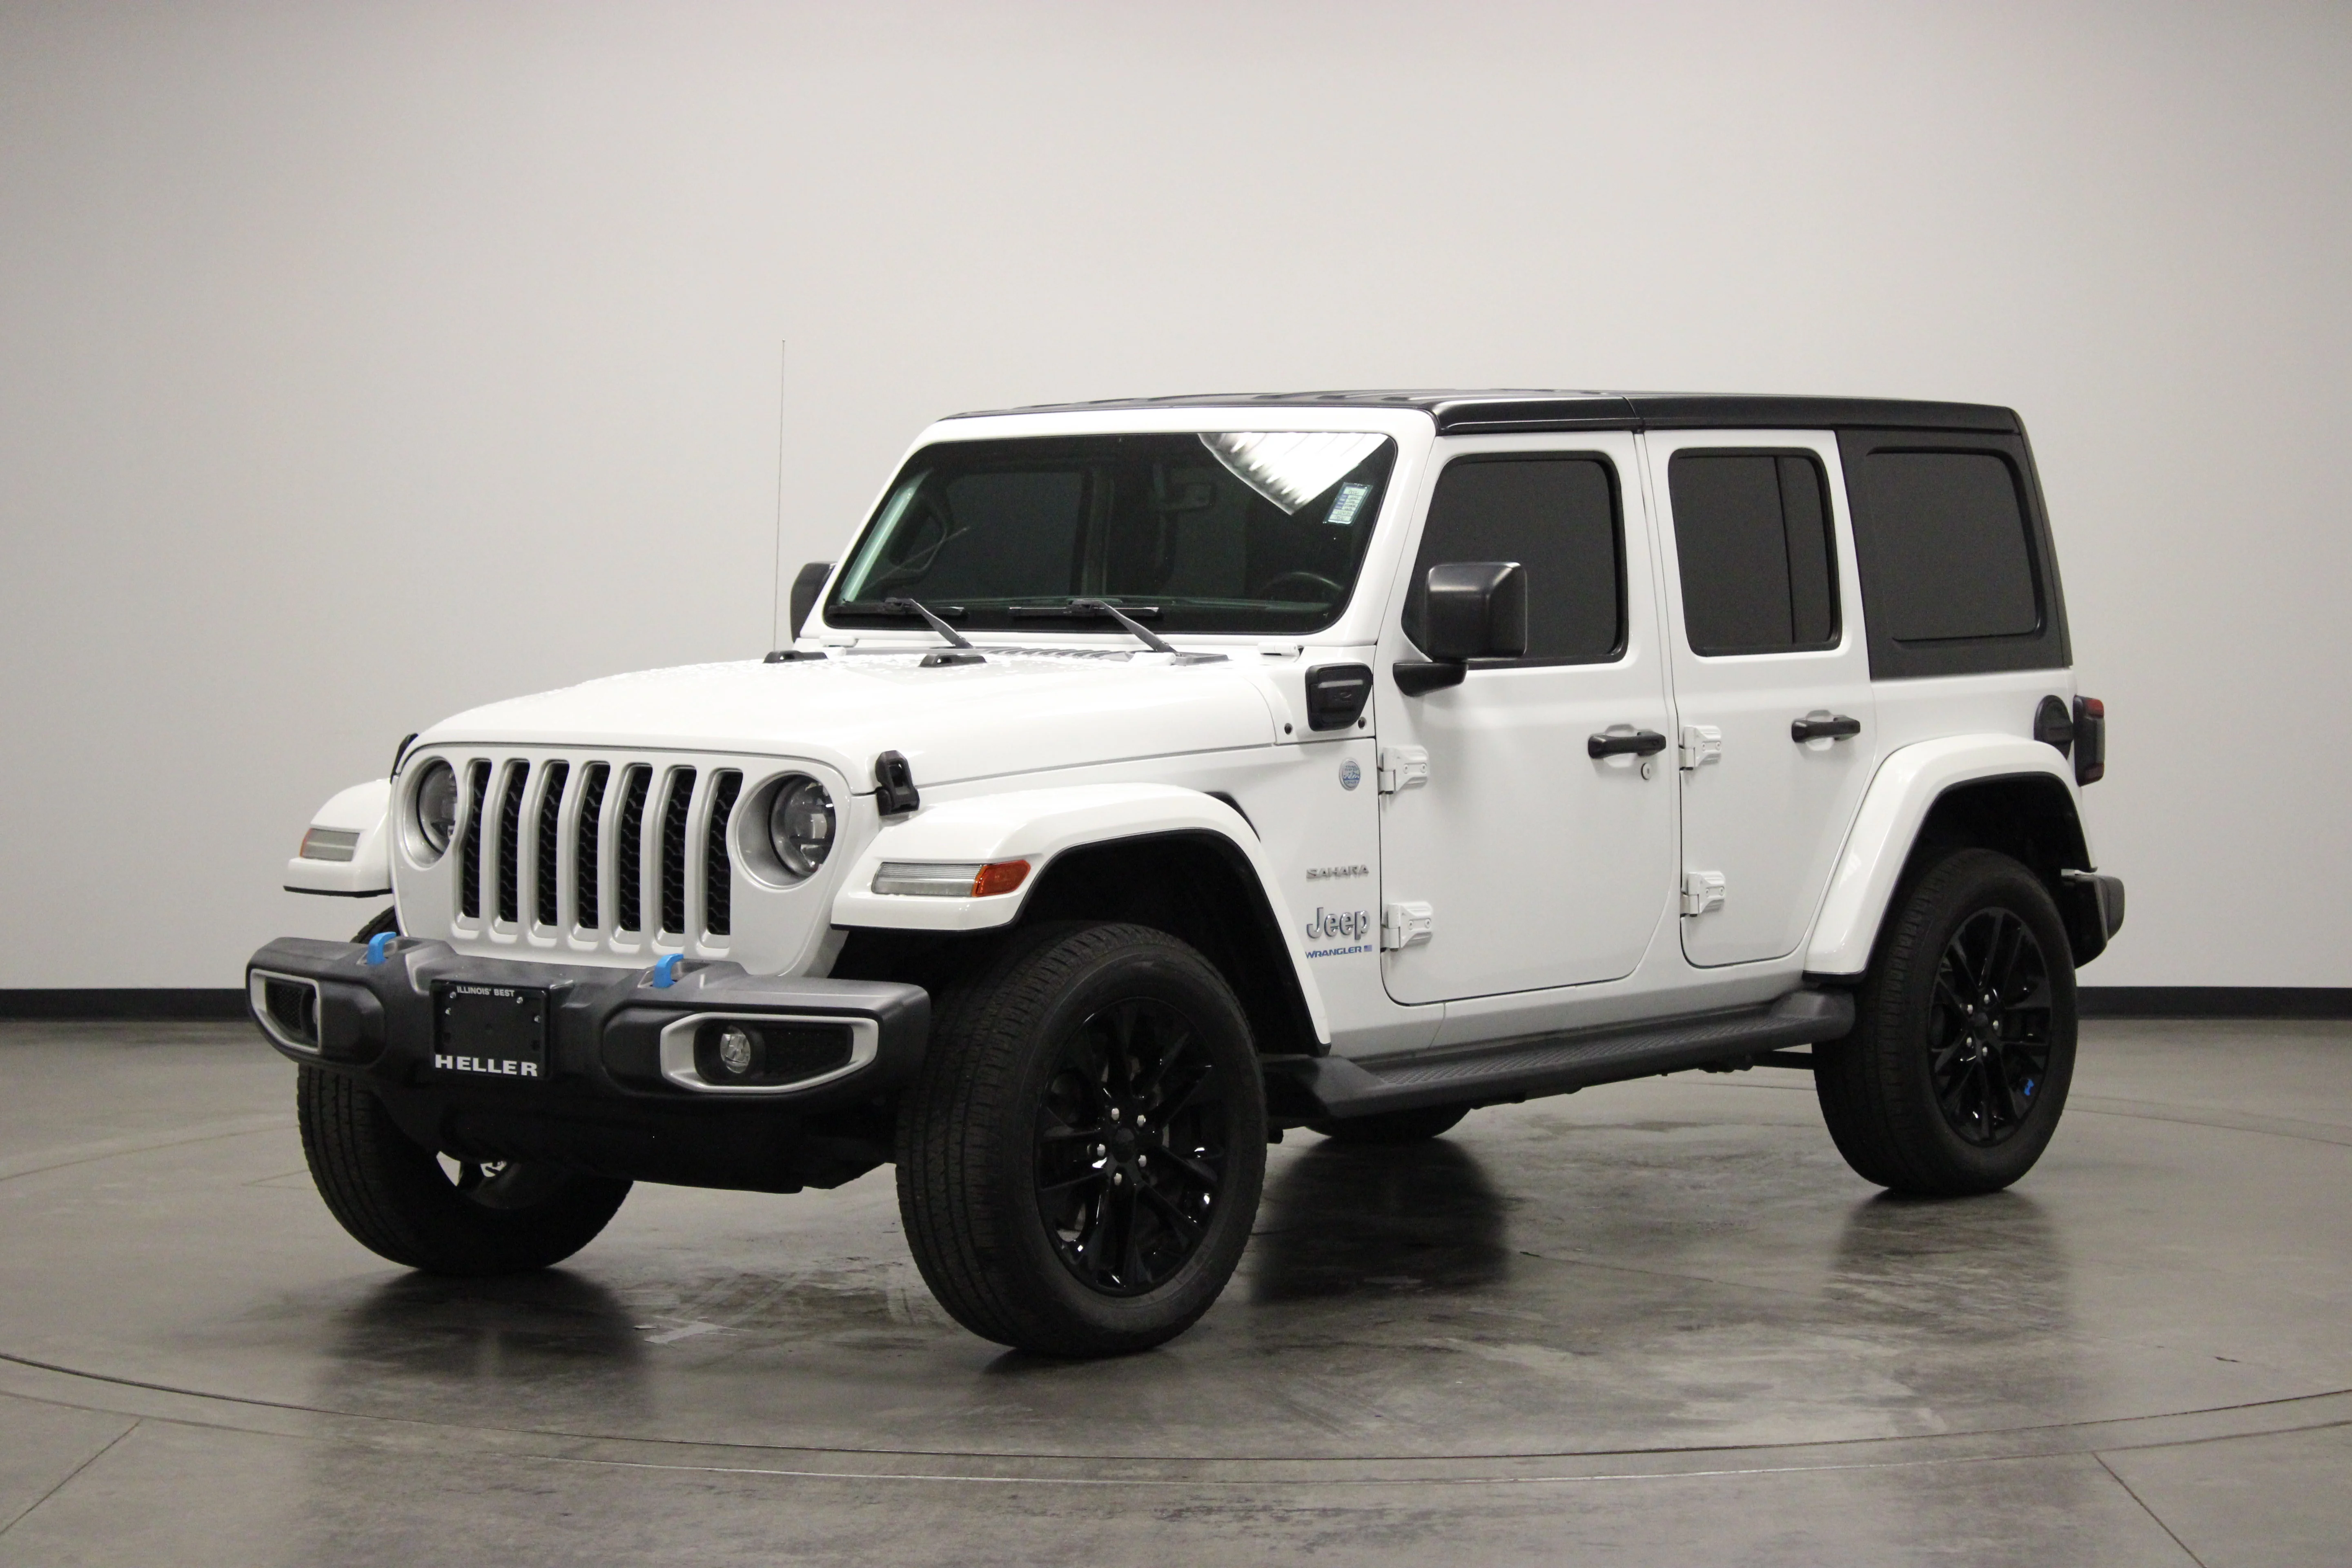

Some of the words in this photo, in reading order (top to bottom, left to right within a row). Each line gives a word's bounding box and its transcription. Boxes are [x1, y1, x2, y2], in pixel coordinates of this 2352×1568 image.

[1306, 864, 1369, 880] SAHARA
[1307, 907, 1370, 940] Jeep
[1305, 946, 1362, 959] WRANGLER
[494, 989, 514, 997] BEST
[435, 1054, 537, 1077] HELLER
